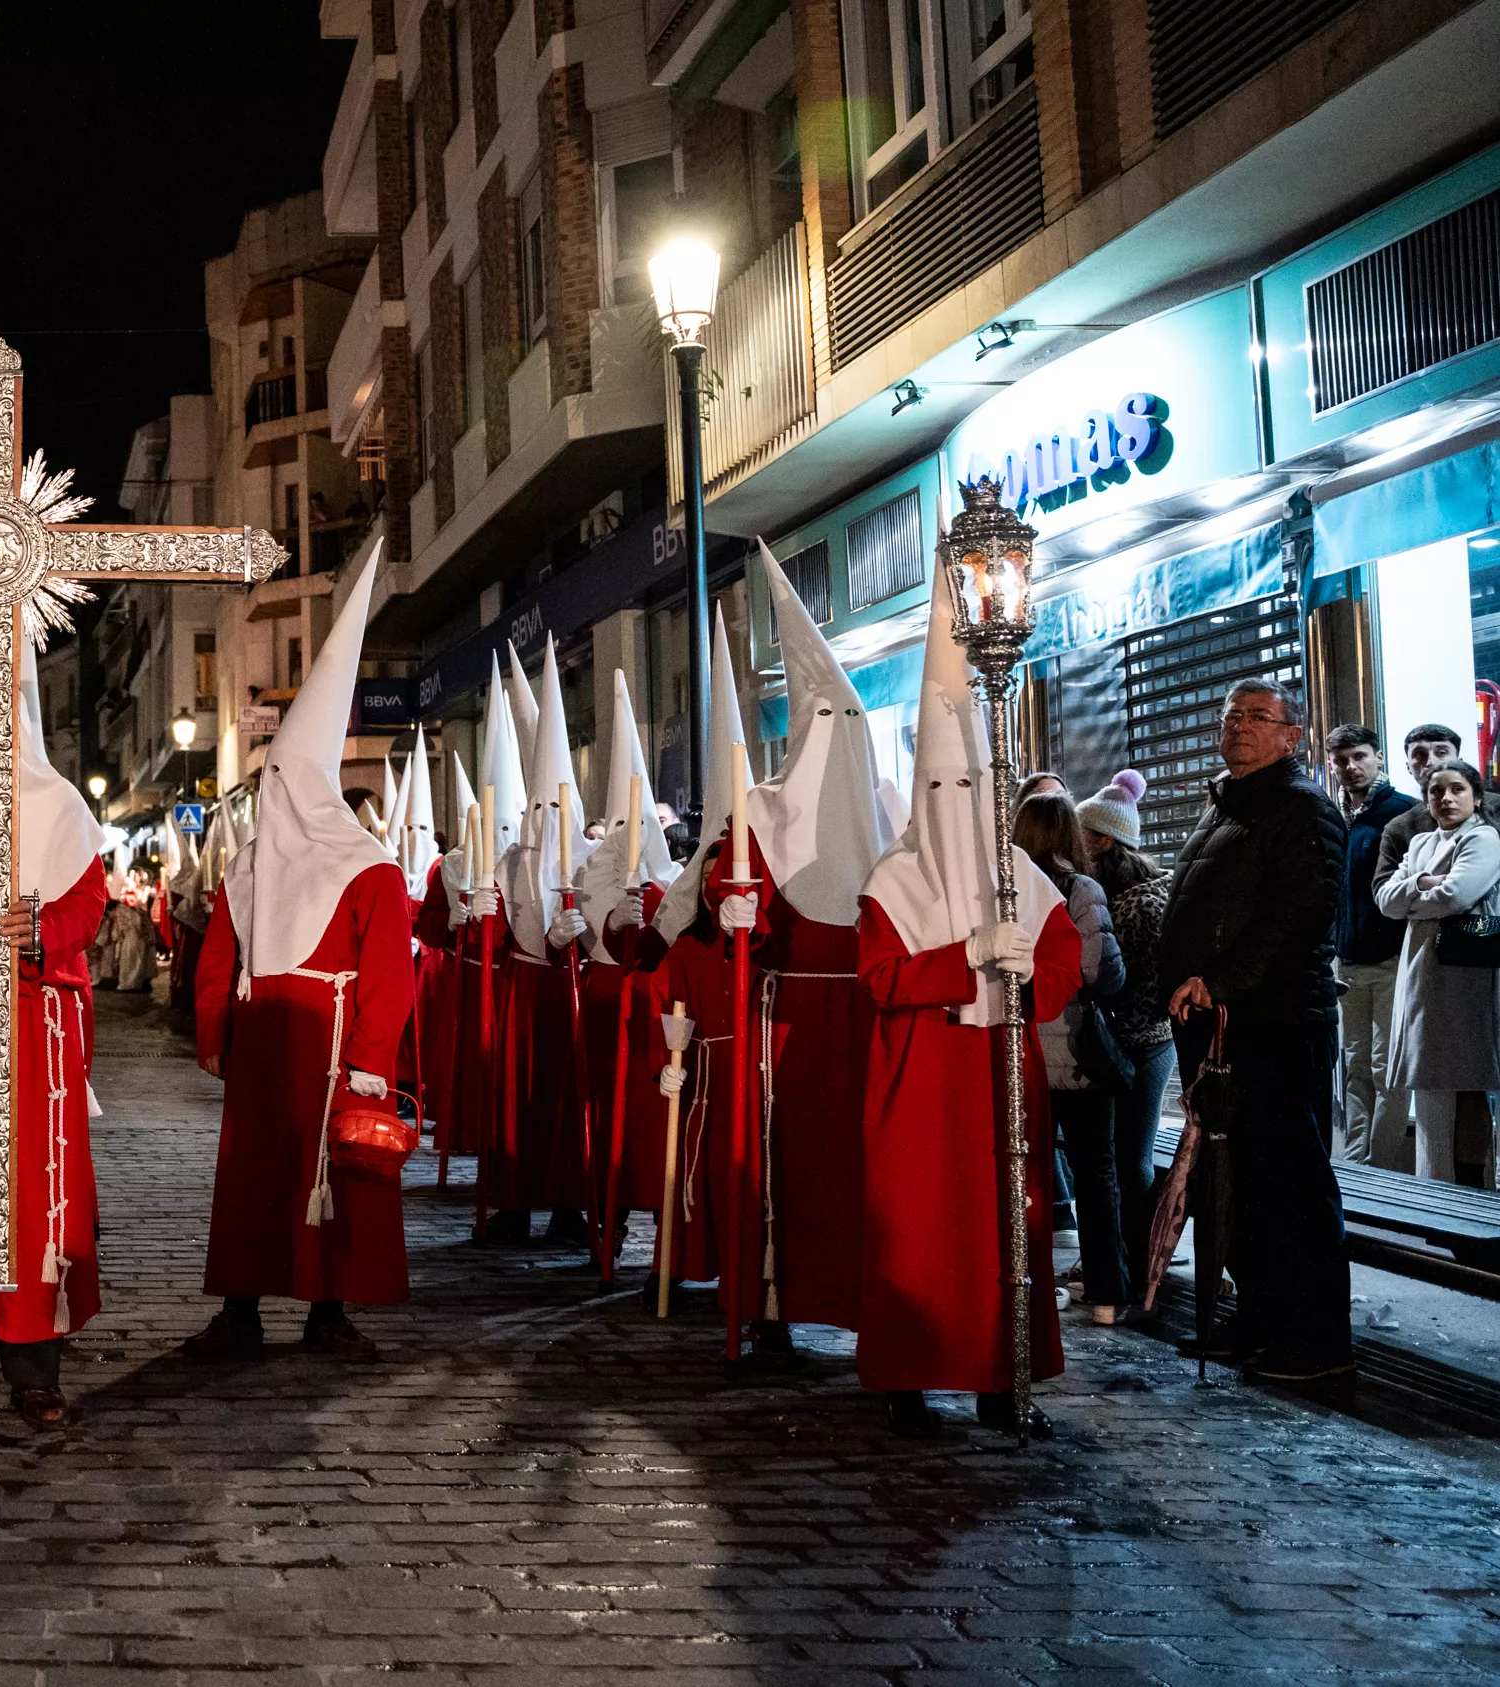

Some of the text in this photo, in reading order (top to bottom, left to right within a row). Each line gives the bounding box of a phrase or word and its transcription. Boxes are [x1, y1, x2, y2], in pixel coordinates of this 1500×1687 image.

[966, 391, 1156, 508] omas
[511, 602, 544, 651] BBVA
[1047, 581, 1171, 652] Aromas
[363, 695, 403, 708] BBVA
[419, 668, 442, 708] BBVA
